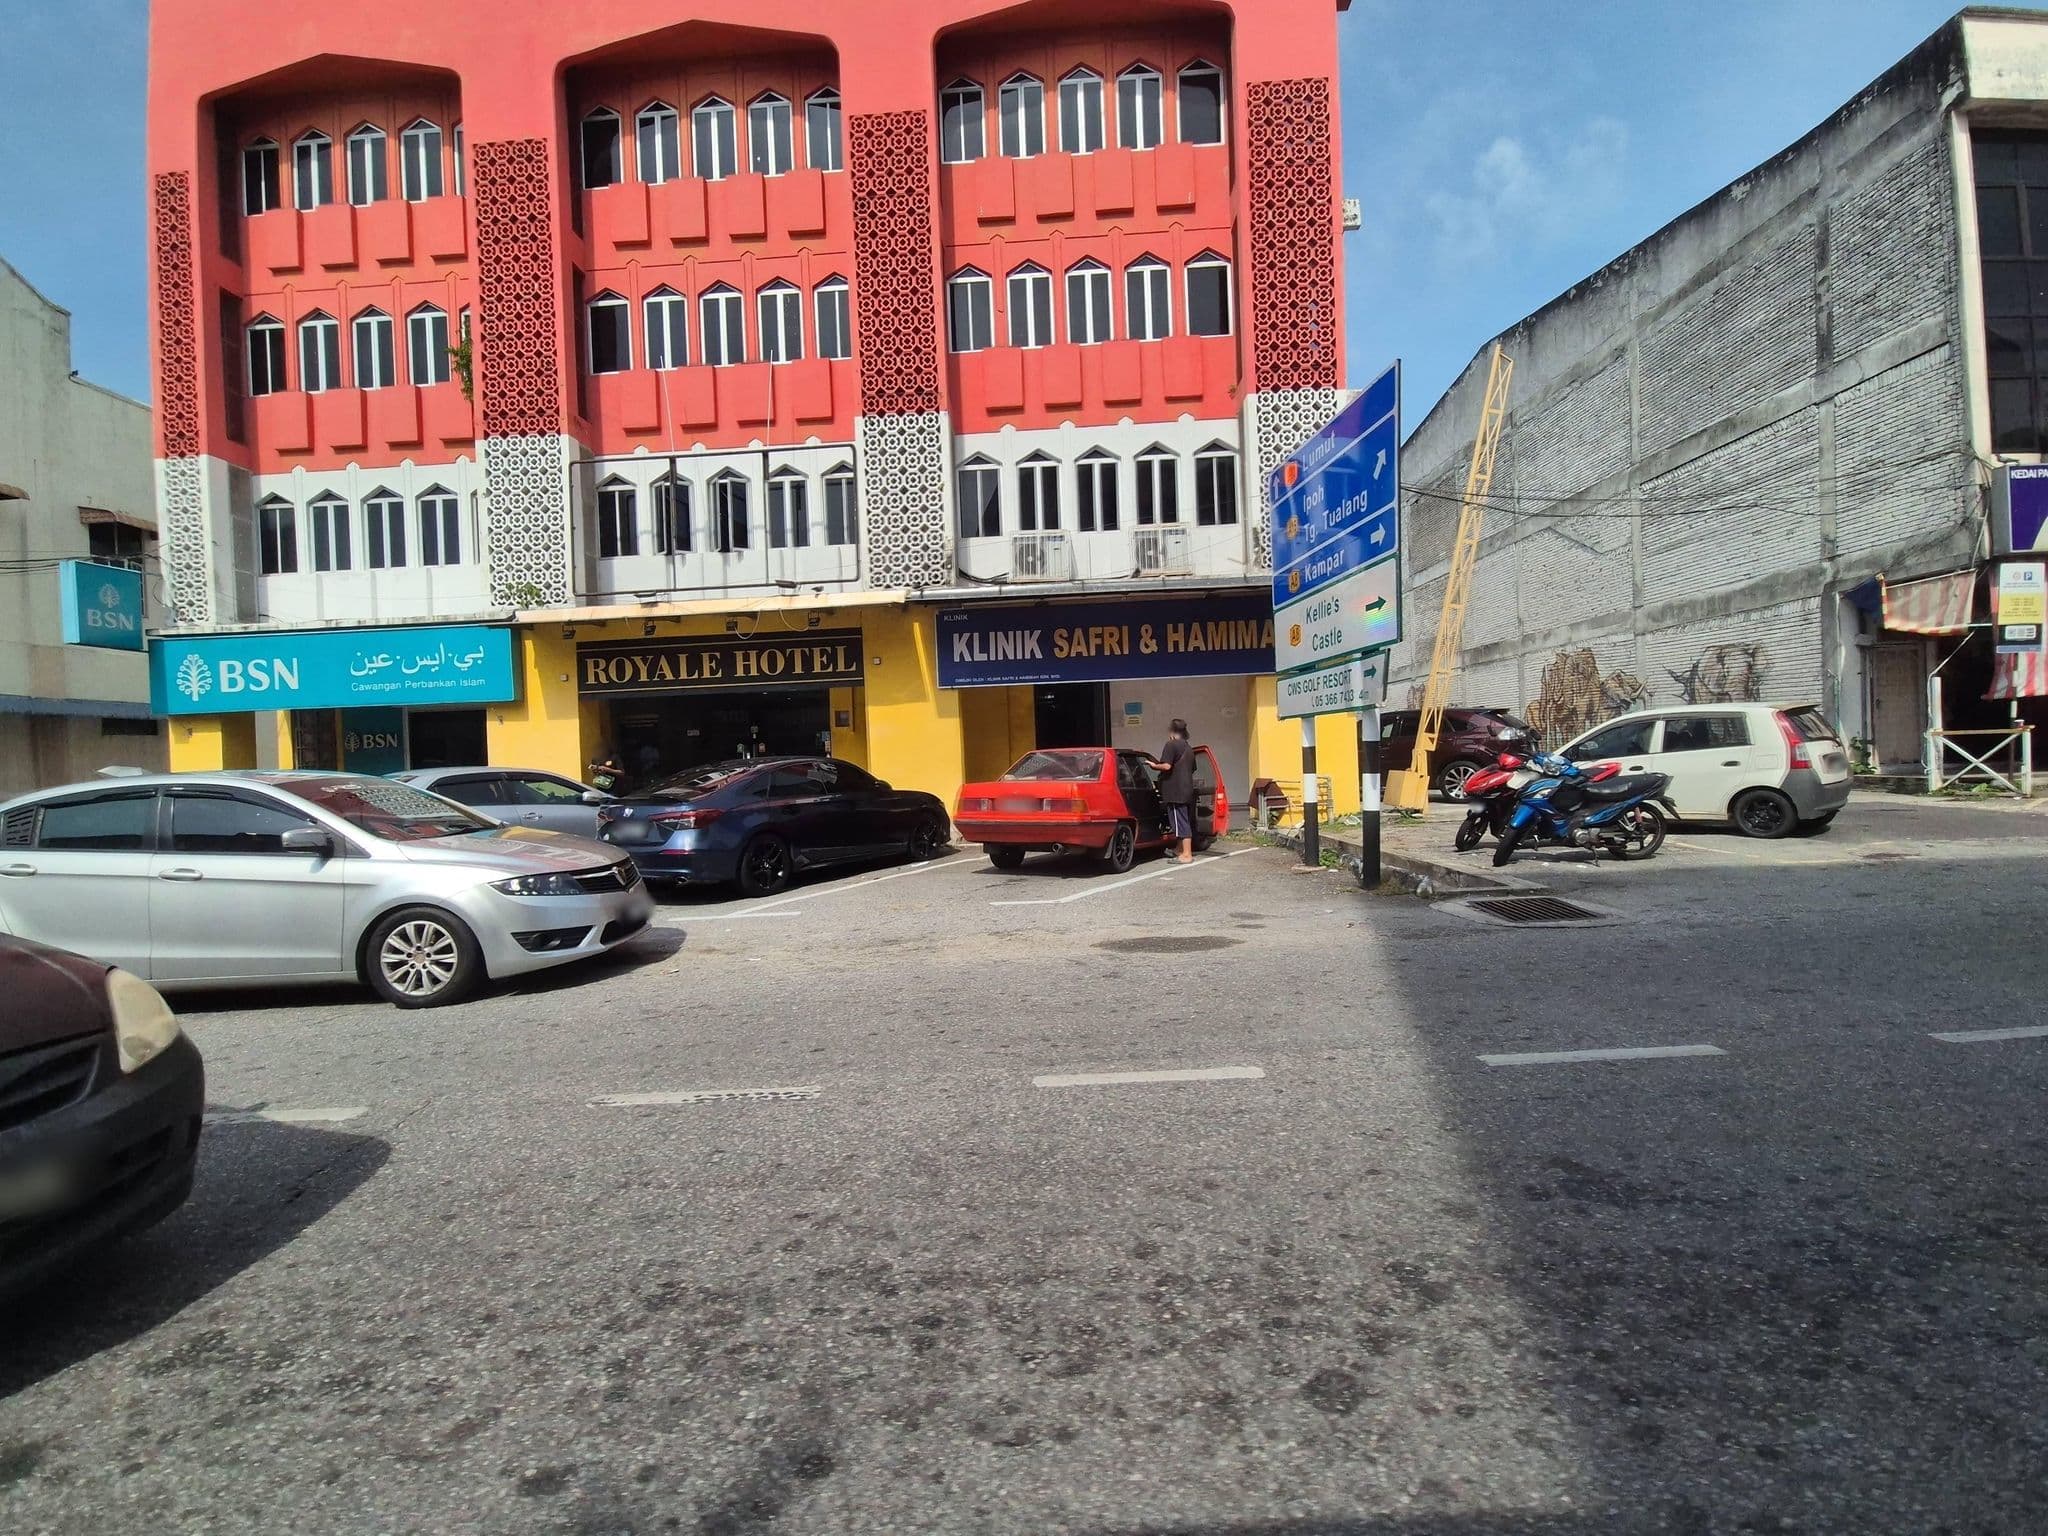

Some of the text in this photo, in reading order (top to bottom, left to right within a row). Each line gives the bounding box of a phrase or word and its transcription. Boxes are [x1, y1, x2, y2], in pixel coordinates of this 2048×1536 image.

[1302, 430, 1335, 472] Lumut
[2011, 469, 2037, 479] KEDAI
[1303, 485, 1325, 513] Ipoh
[1303, 522, 1318, 543] Tg.
[1322, 489, 1368, 530] Tualang
[1304, 549, 1345, 583] Kampar
[87, 609, 134, 631] BSN
[944, 614, 968, 622] KLINIK
[1306, 596, 1340, 624] Kellie's
[953, 630, 1043, 662] KLINIK
[1053, 625, 1129, 659] SAFRI
[1140, 624, 1158, 655] &
[1312, 627, 1342, 651] Castle
[219, 657, 300, 693] BSN
[585, 646, 857, 685] ROYALE HOTEL
[351, 678, 486, 692] Cawangan Perbankan Islam
[1303, 676, 1321, 692] GOLF
[1322, 669, 1352, 689] RESORT
[1325, 691, 1338, 706] 366
[362, 733, 398, 749] BSN
